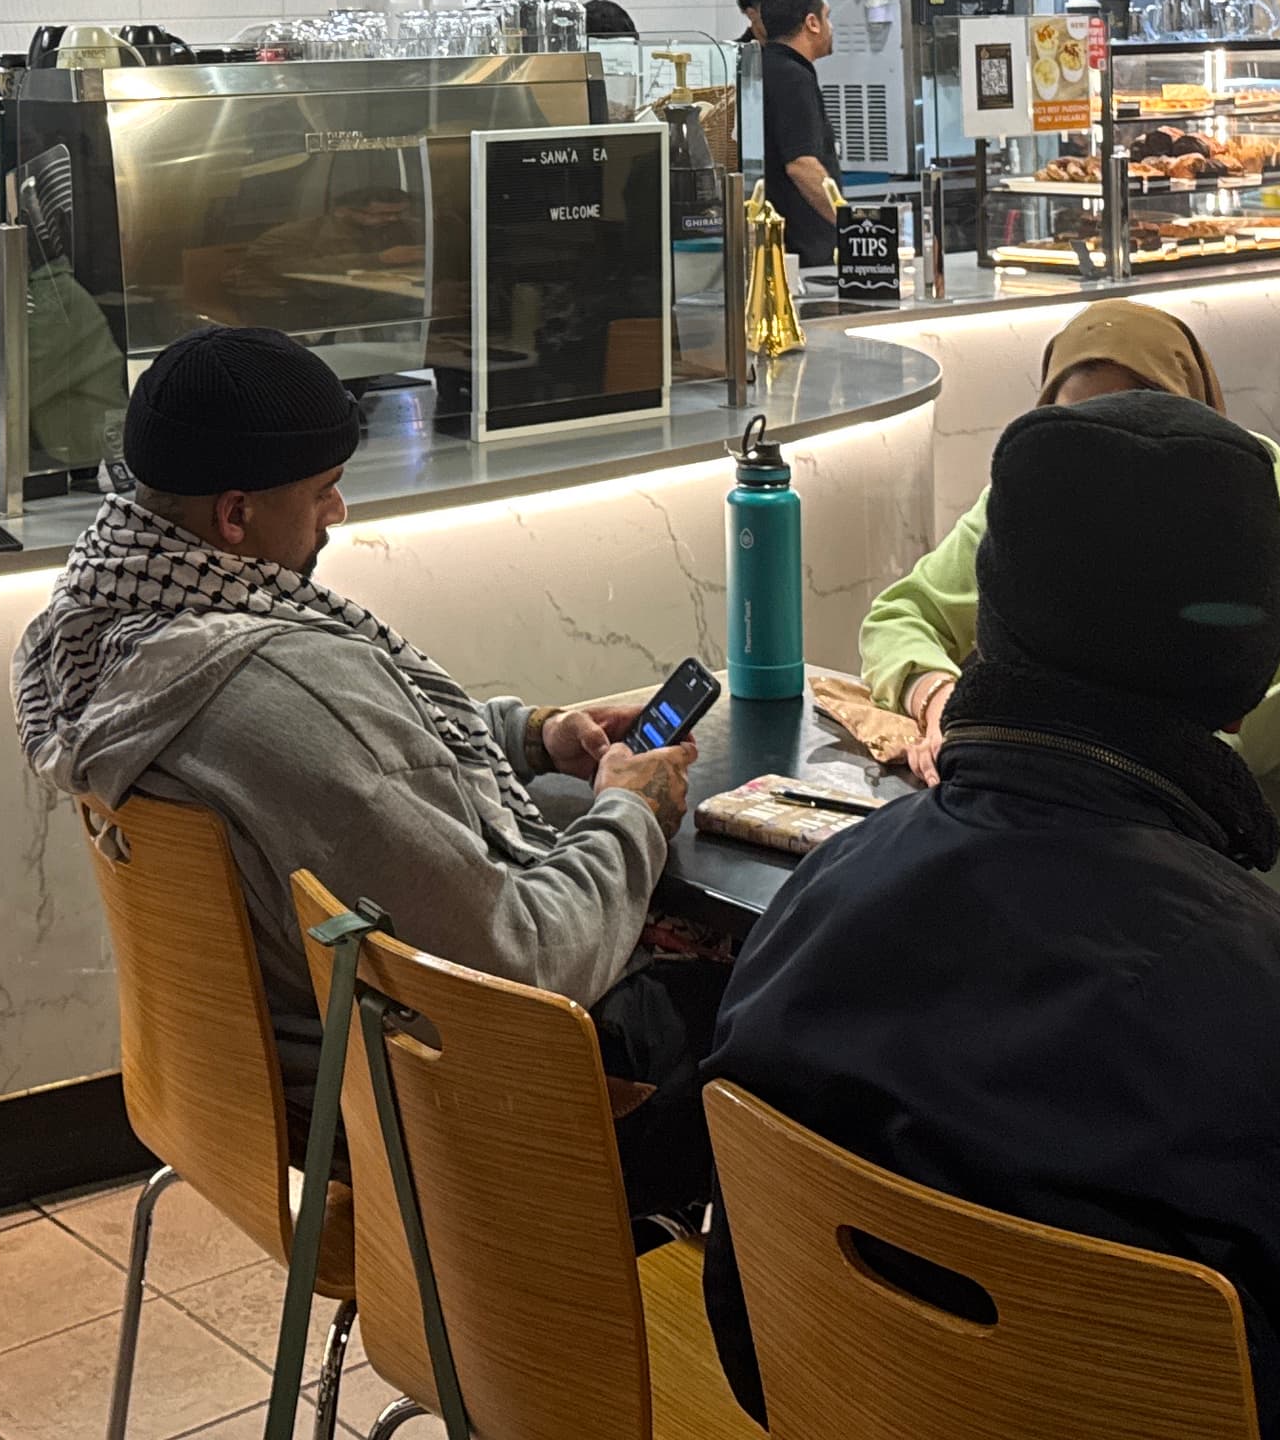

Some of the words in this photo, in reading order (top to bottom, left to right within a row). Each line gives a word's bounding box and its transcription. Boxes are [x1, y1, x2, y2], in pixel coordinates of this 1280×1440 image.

[540, 147, 578, 164] SANA'A
[593, 148, 608, 162] EA
[550, 205, 601, 221] WELCOME
[849, 237, 888, 257] TIPS
[842, 265, 853, 273] are
[855, 264, 895, 275] appreciated
